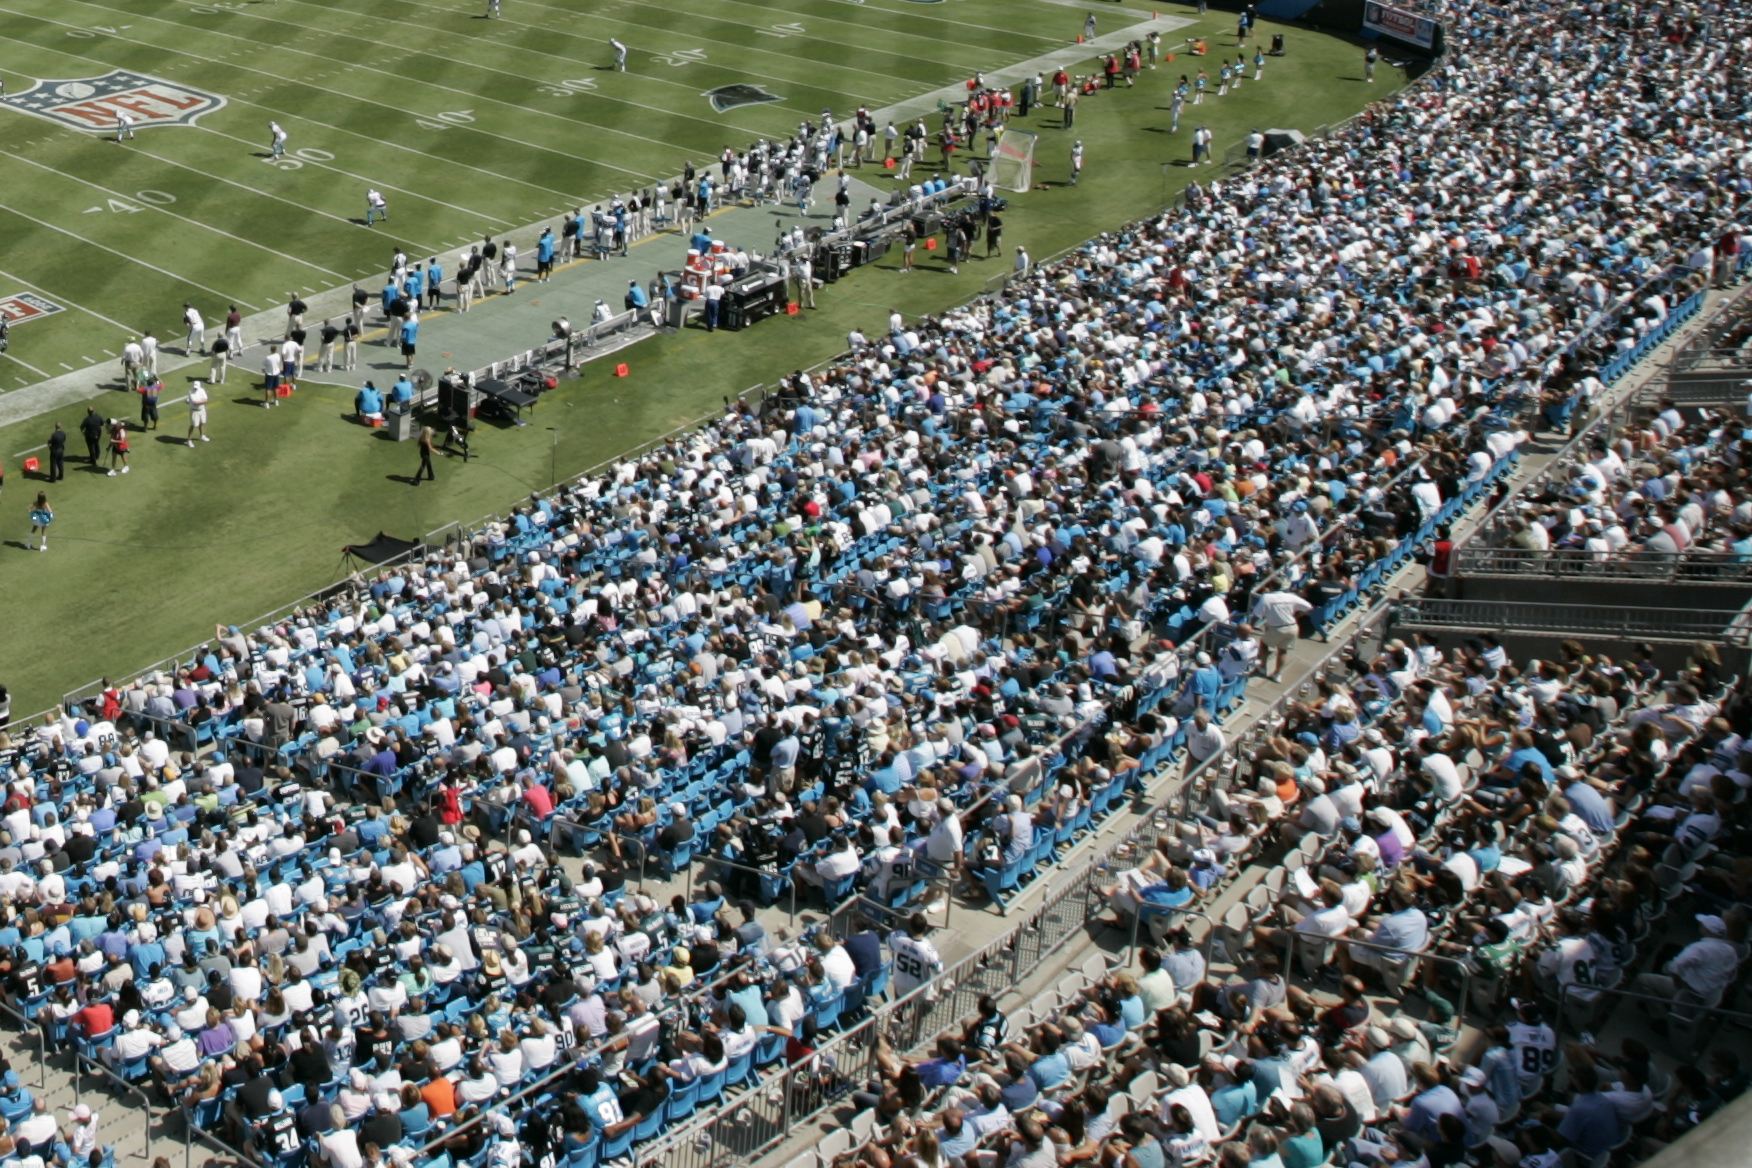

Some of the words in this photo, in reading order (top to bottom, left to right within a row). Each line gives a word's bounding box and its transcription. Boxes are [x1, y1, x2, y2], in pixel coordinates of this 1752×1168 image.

[649, 49, 707, 67] 20
[536, 78, 597, 98] 30
[52, 90, 205, 125] NFL
[415, 111, 476, 131] 40
[107, 189, 177, 214] 40
[896, 953, 923, 979] 52
[27, 978, 40, 996] 5
[1522, 1045, 1555, 1074] 89
[274, 1127, 300, 1151] 34
